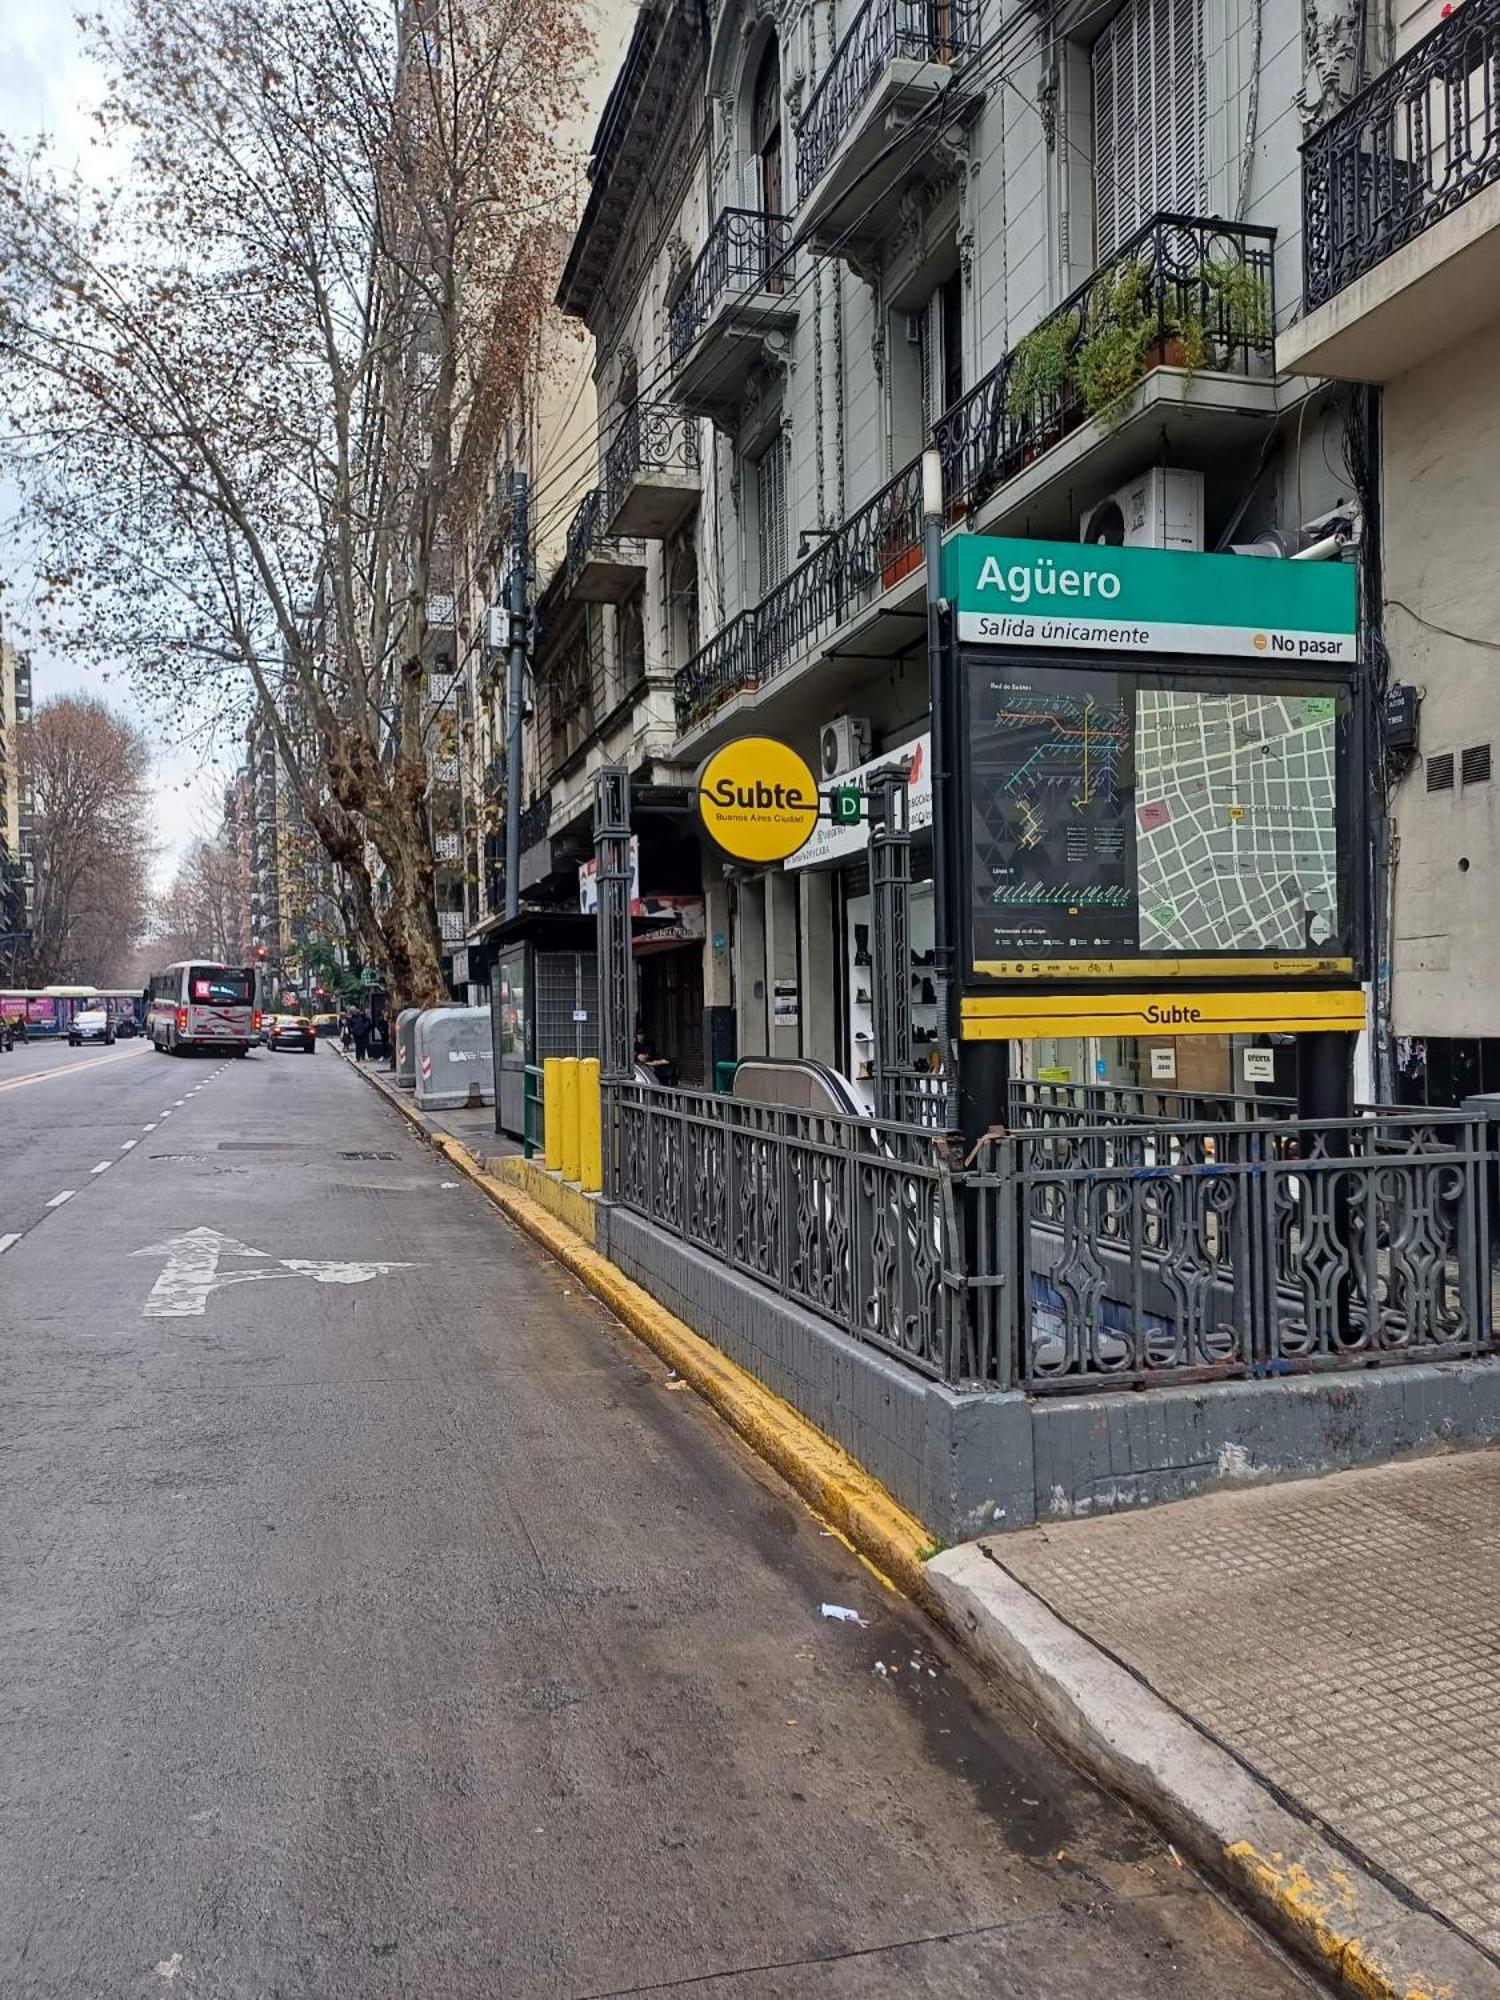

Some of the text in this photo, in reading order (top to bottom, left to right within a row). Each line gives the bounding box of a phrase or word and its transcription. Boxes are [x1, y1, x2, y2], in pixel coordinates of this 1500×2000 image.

[975, 555, 1122, 603] Agüero
[978, 617, 1150, 646] Salida únicamente
[1271, 634, 1343, 657] No pasar
[716, 779, 803, 809] Subte
[843, 797, 857, 815] D
[716, 813, 804, 824] Buenos Aires Ciudad
[1147, 1004, 1201, 1024] Subte
